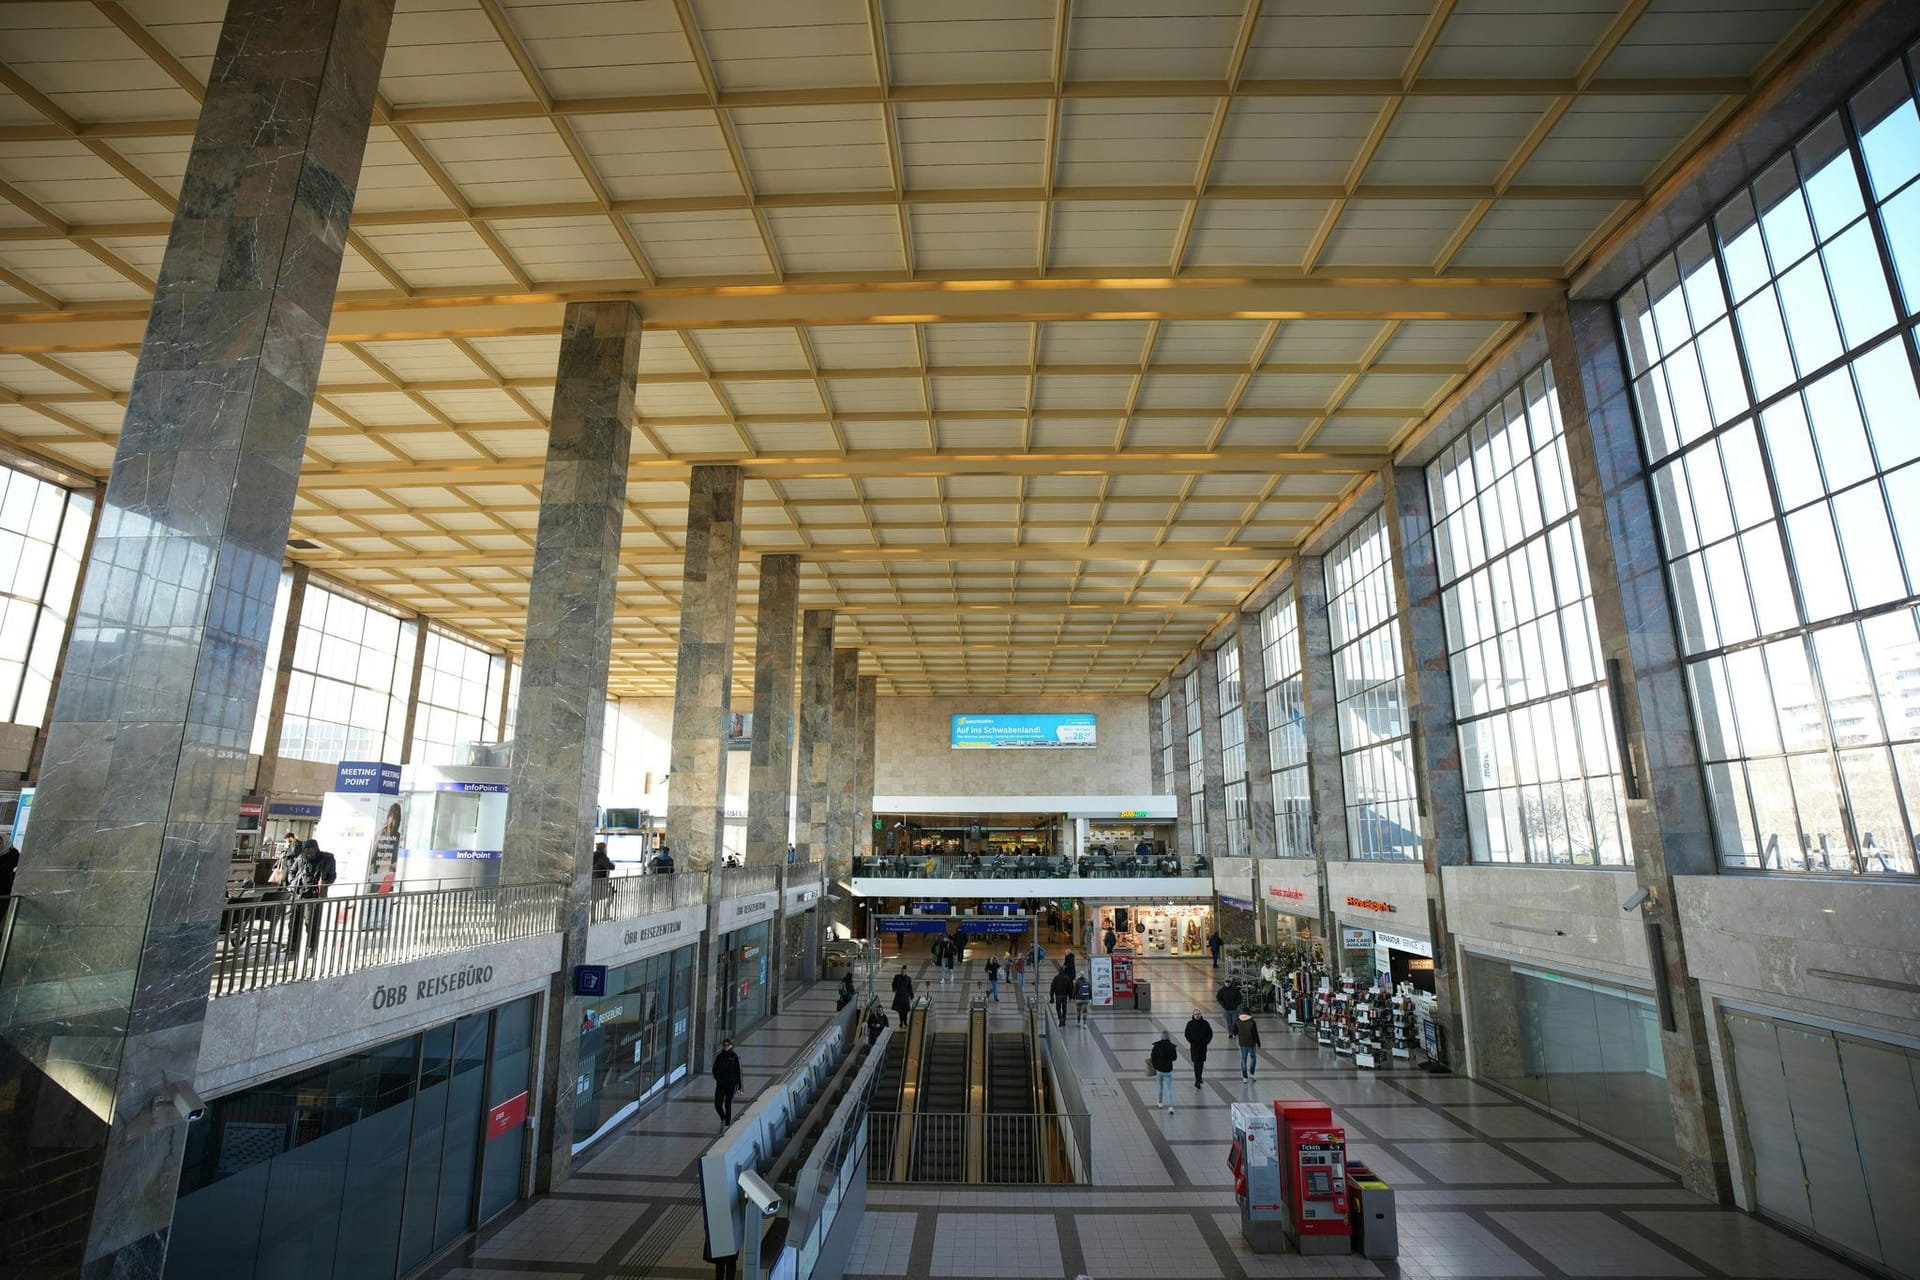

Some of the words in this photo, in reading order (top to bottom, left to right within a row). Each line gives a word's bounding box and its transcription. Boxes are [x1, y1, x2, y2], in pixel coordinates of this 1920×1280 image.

[340, 768, 377, 776] MEETING
[381, 769, 400, 779] MEETING
[344, 778, 371, 786] POINT
[382, 780, 397, 788] POINT
[464, 784, 498, 792] InfoPoint
[456, 851, 491, 860] InfoPoint
[624, 930, 638, 946] ÖBB
[640, 920, 681, 941] REISEZENTRUM
[372, 984, 408, 1011] ÖBB
[416, 964, 493, 1001] REISEBÜRO
